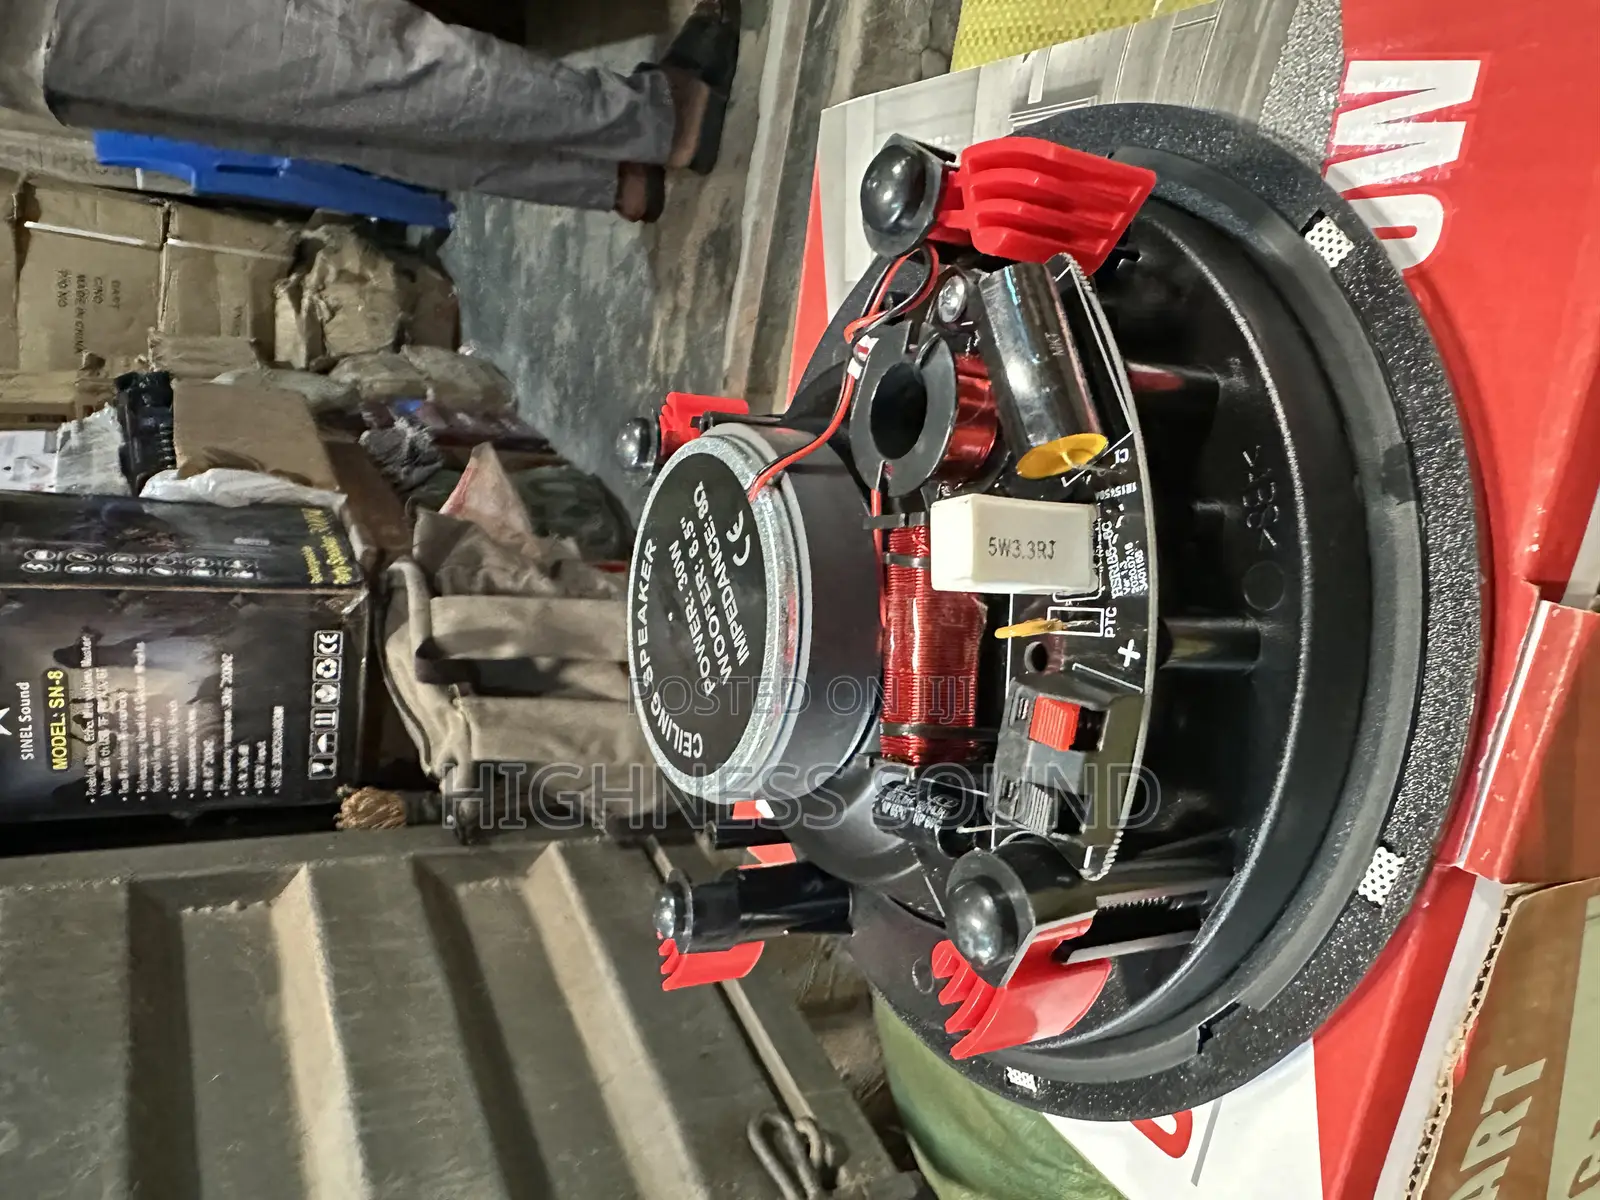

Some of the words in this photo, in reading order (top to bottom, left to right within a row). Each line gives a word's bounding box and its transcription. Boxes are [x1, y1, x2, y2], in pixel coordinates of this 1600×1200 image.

[1044, 331, 1066, 356] MKT
[693, 481, 710, 520] 8Ω
[668, 540, 688, 591] 30W
[988, 536, 1057, 561] 5W3.3RJ
[637, 538, 656, 687] SPEAKER
[702, 515, 750, 666] IMPEDANCE:
[684, 590, 716, 696] POWER:
[693, 559, 732, 685] WOOFER:
[1103, 606, 1118, 639] PTC
[16, 682, 32, 722] Sound
[47, 670, 65, 708] SN-8
[19, 724, 35, 760] SINEL
[50, 713, 68, 769] MODEL:
[650, 691, 703, 759] CEILING
